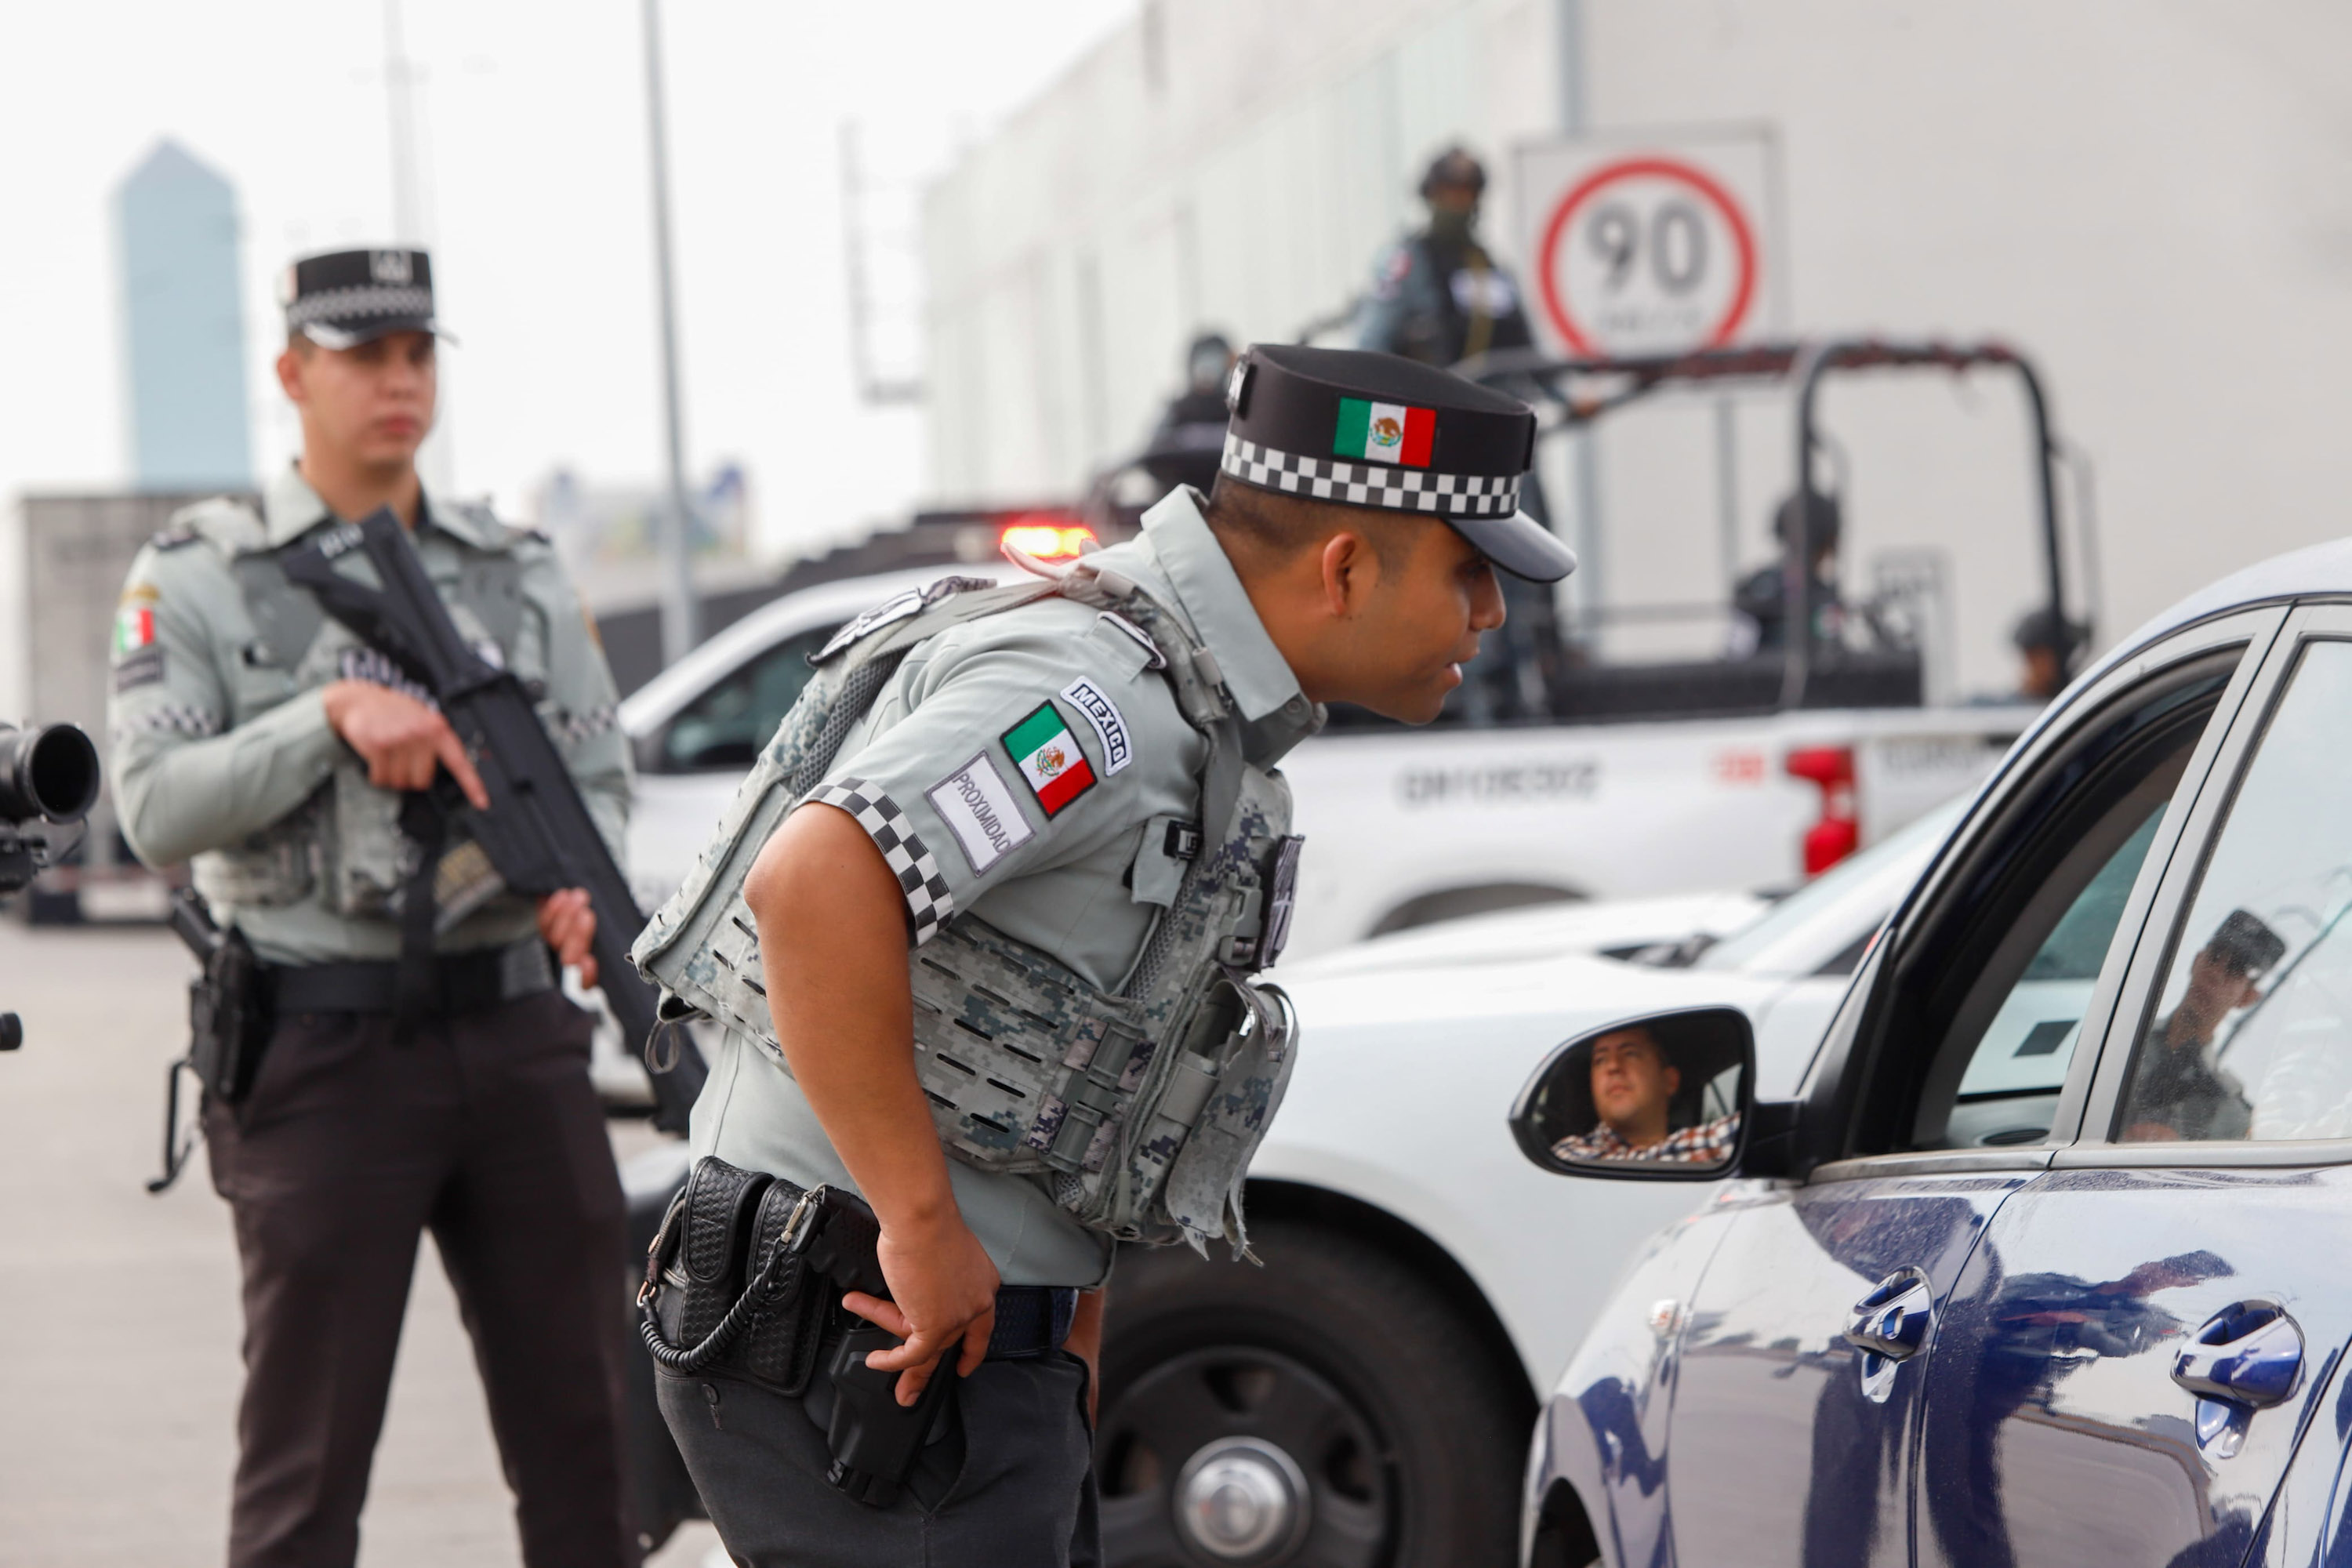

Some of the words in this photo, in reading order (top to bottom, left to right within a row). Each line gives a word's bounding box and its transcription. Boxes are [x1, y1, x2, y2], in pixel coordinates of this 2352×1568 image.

[1584, 200, 1708, 298] 90
[1073, 685, 1126, 763] MEXICO
[952, 772, 1011, 853] PROXIMIDAD
